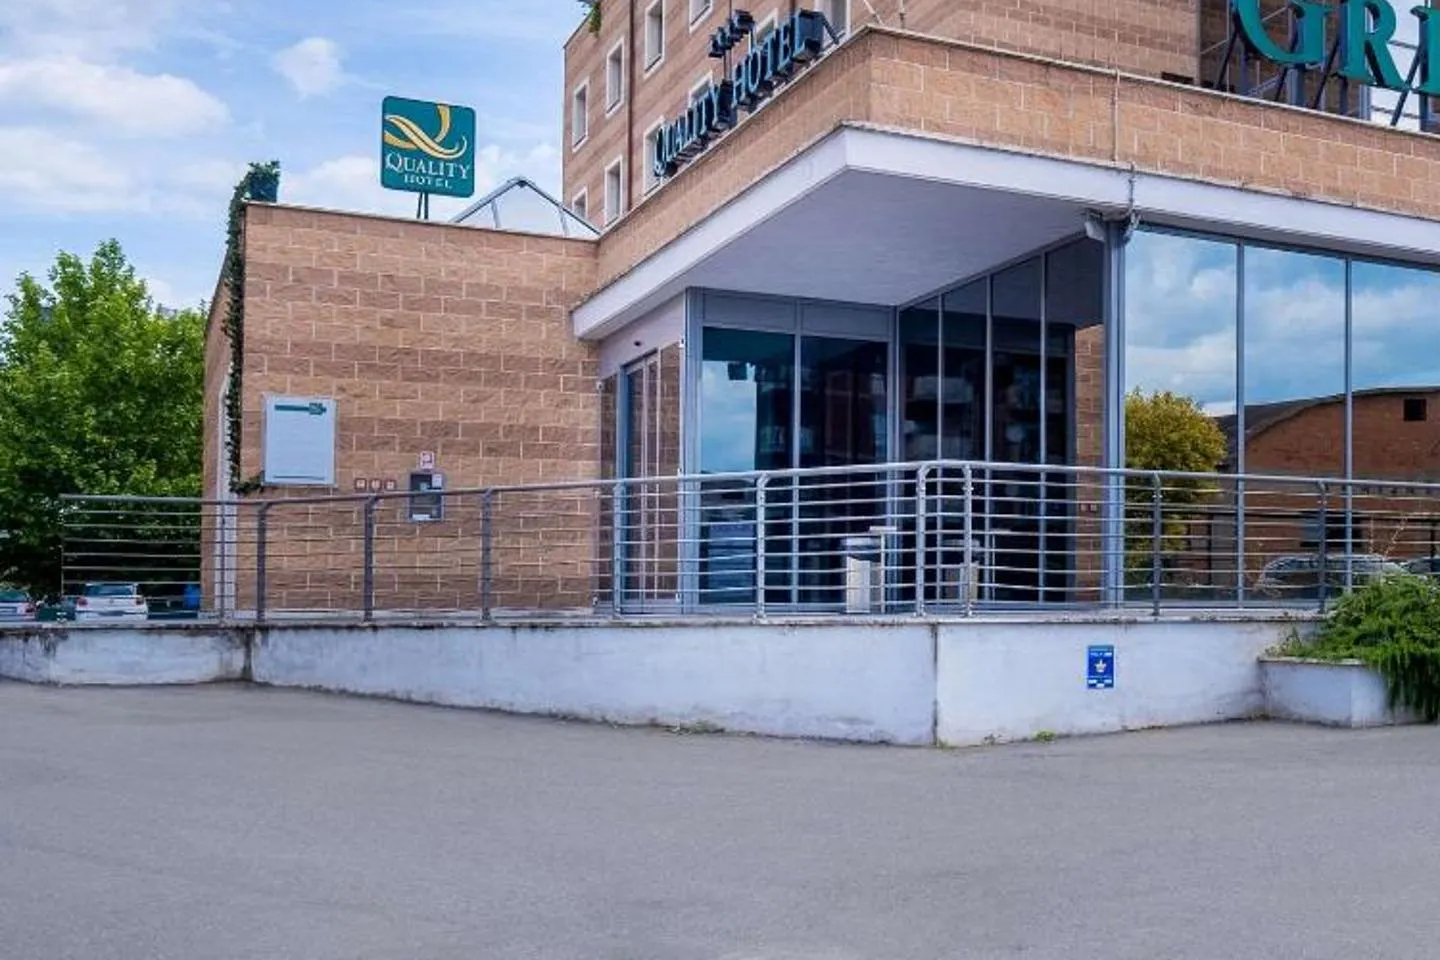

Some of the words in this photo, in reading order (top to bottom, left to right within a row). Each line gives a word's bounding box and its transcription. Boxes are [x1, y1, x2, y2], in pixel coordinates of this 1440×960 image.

[733, 9, 824, 108] HOTEL
[385, 151, 470, 179] QUALITY
[404, 173, 453, 189] HOTEL
